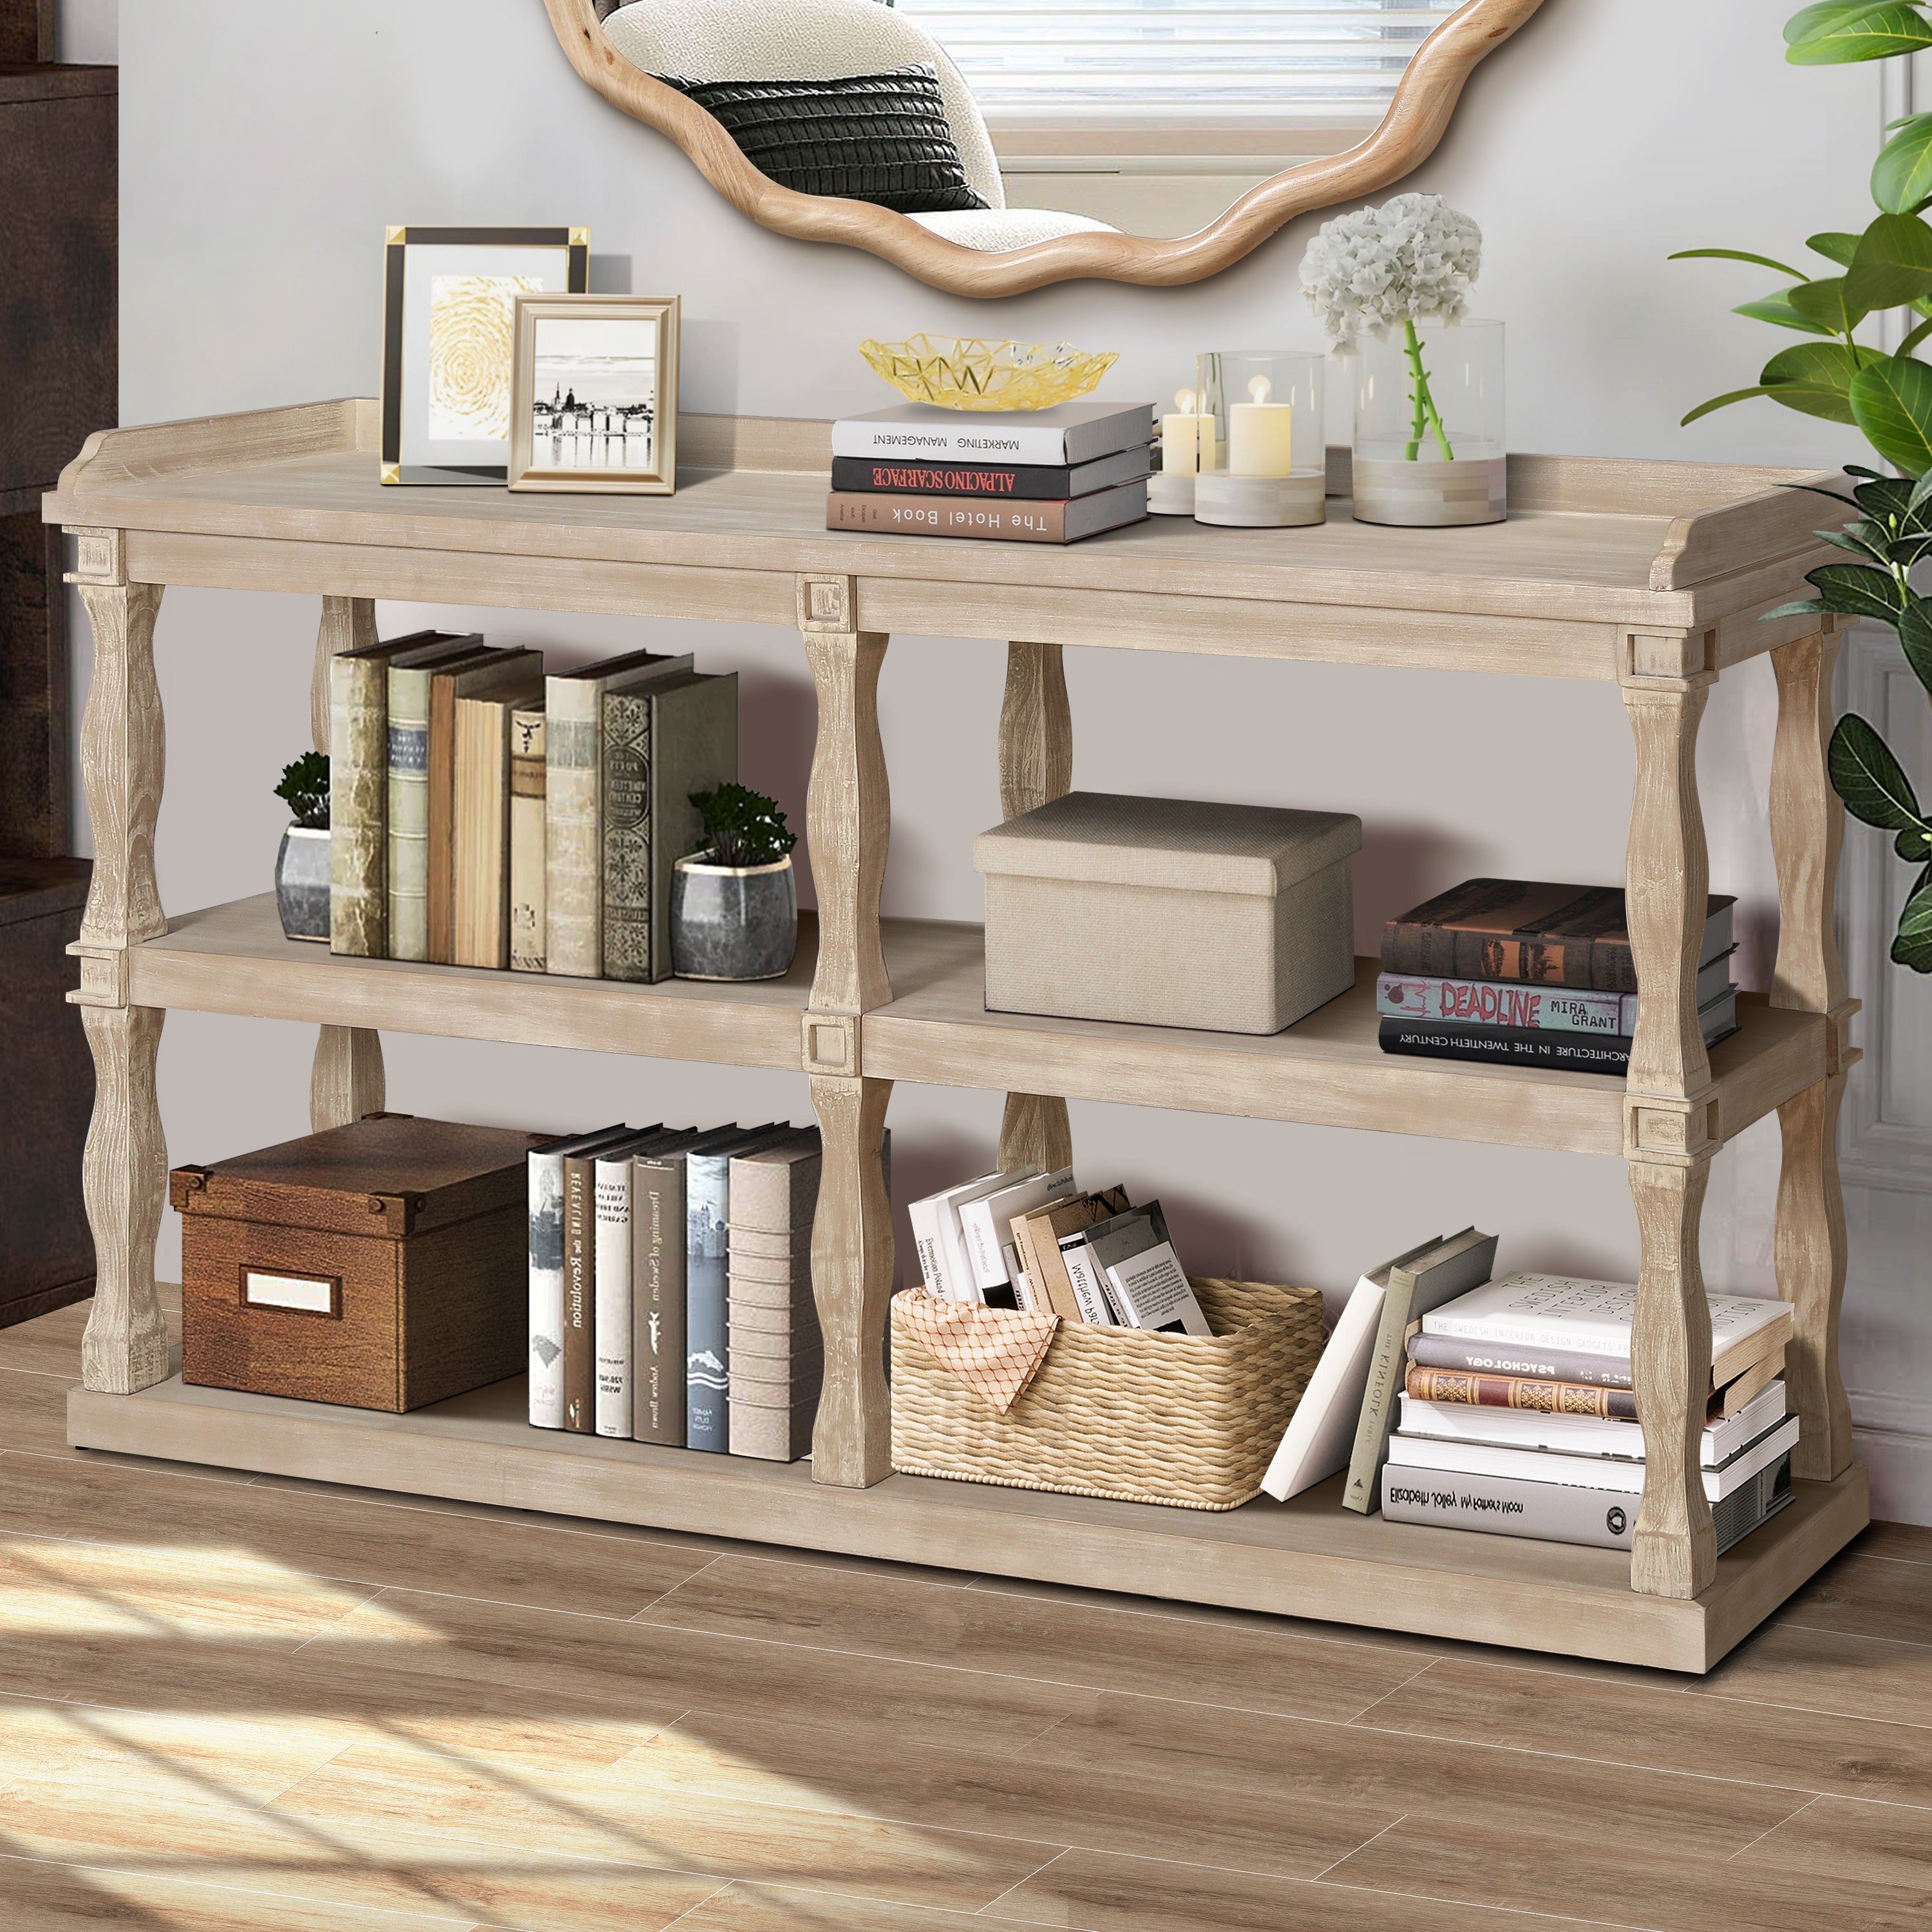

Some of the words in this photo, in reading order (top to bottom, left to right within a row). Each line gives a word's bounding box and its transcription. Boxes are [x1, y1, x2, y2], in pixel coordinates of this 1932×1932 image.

[873, 435, 947, 447] MANAGEMENT
[957, 438, 1019, 450] MARKETING
[873, 468, 943, 489] SCARFACE
[893, 508, 938, 525] Book
[950, 511, 1000, 528] Hotel
[1012, 515, 1047, 531] The
[1440, 982, 1542, 1028] DEADLINE
[1551, 1000, 1587, 1015] MIRA
[1571, 1014, 1616, 1029] GRANT
[1399, 1034, 1448, 1046] CENTURY
[1450, 1038, 1510, 1051] TWENTIETH
[1514, 1043, 1535, 1054] THE
[1539, 1045, 1551, 1054] IN
[1501, 1276, 1544, 1289] THE
[1508, 1280, 1580, 1310] SWEDISH
[1537, 1284, 1618, 1318] INTERIOR
[1434, 1321, 1448, 1331] THE
[1453, 1323, 1489, 1336] SWEDISH
[1494, 1329, 1535, 1341] INTERIOR
[1540, 1334, 1571, 1346] DESIGN
[1576, 1340, 1613, 1350] GADGETS
